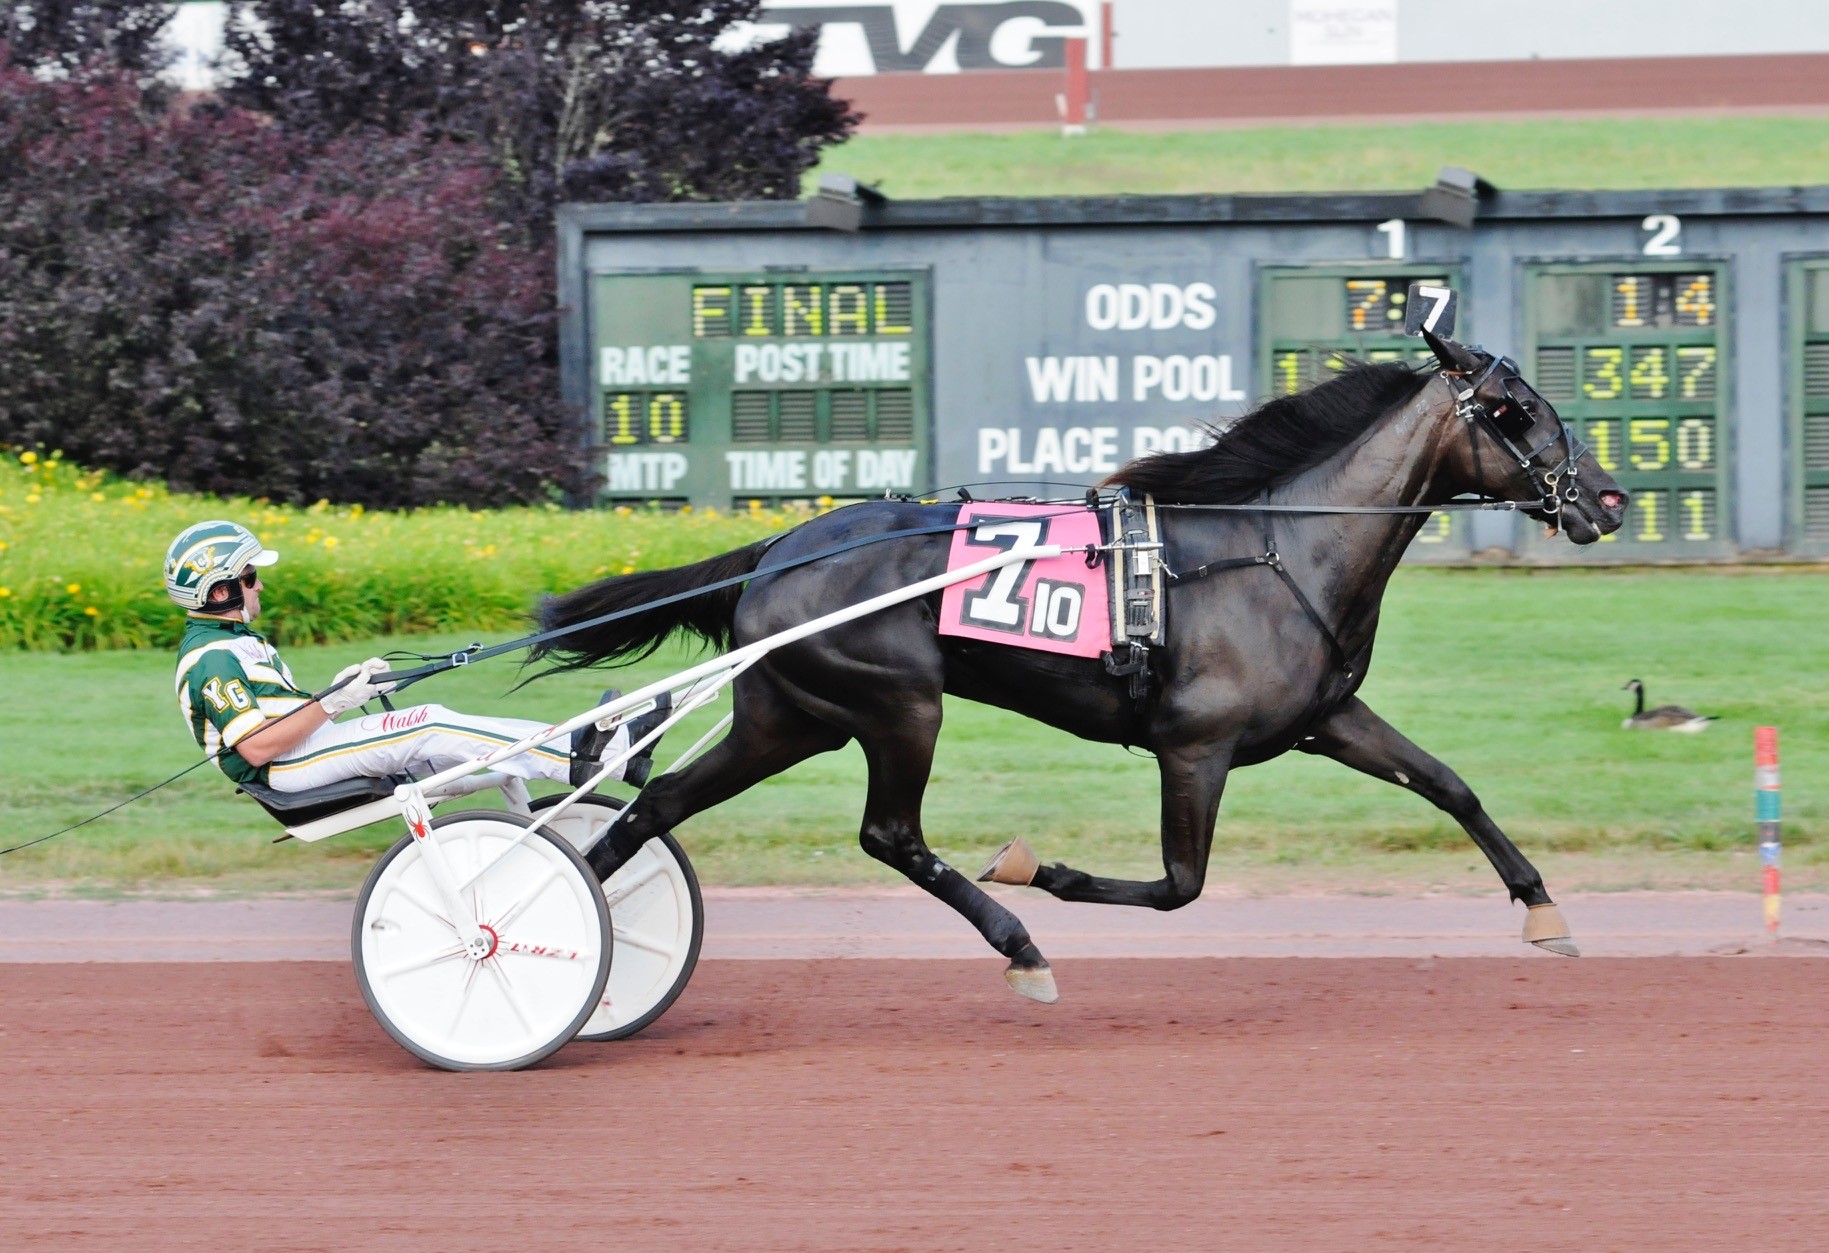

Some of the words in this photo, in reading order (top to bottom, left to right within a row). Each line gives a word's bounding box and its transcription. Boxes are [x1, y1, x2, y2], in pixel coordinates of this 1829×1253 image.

[1377, 218, 1405, 260] 1
[1642, 214, 1682, 256] 2
[693, 285, 913, 337] FINAL
[1085, 282, 1217, 331] ODDS
[1418, 286, 1451, 337] 7
[600, 345, 691, 385] RACE
[735, 343, 824, 384] POST
[828, 341, 911, 382] TIME
[1026, 356, 1119, 403] WIN
[1134, 354, 1246, 401] POOL
[1583, 348, 1717, 398] 347
[610, 394, 683, 445] 10
[978, 427, 1118, 474] PLACE
[1589, 419, 1711, 471] 150
[607, 452, 688, 491] MTP
[726, 450, 806, 490] TIME
[813, 449, 851, 489] OF
[856, 449, 917, 489] DAY
[966, 516, 1046, 630] 7
[1030, 582, 1083, 637] 10
[202, 676, 251, 714] YG
[361, 705, 428, 732] Walsh
